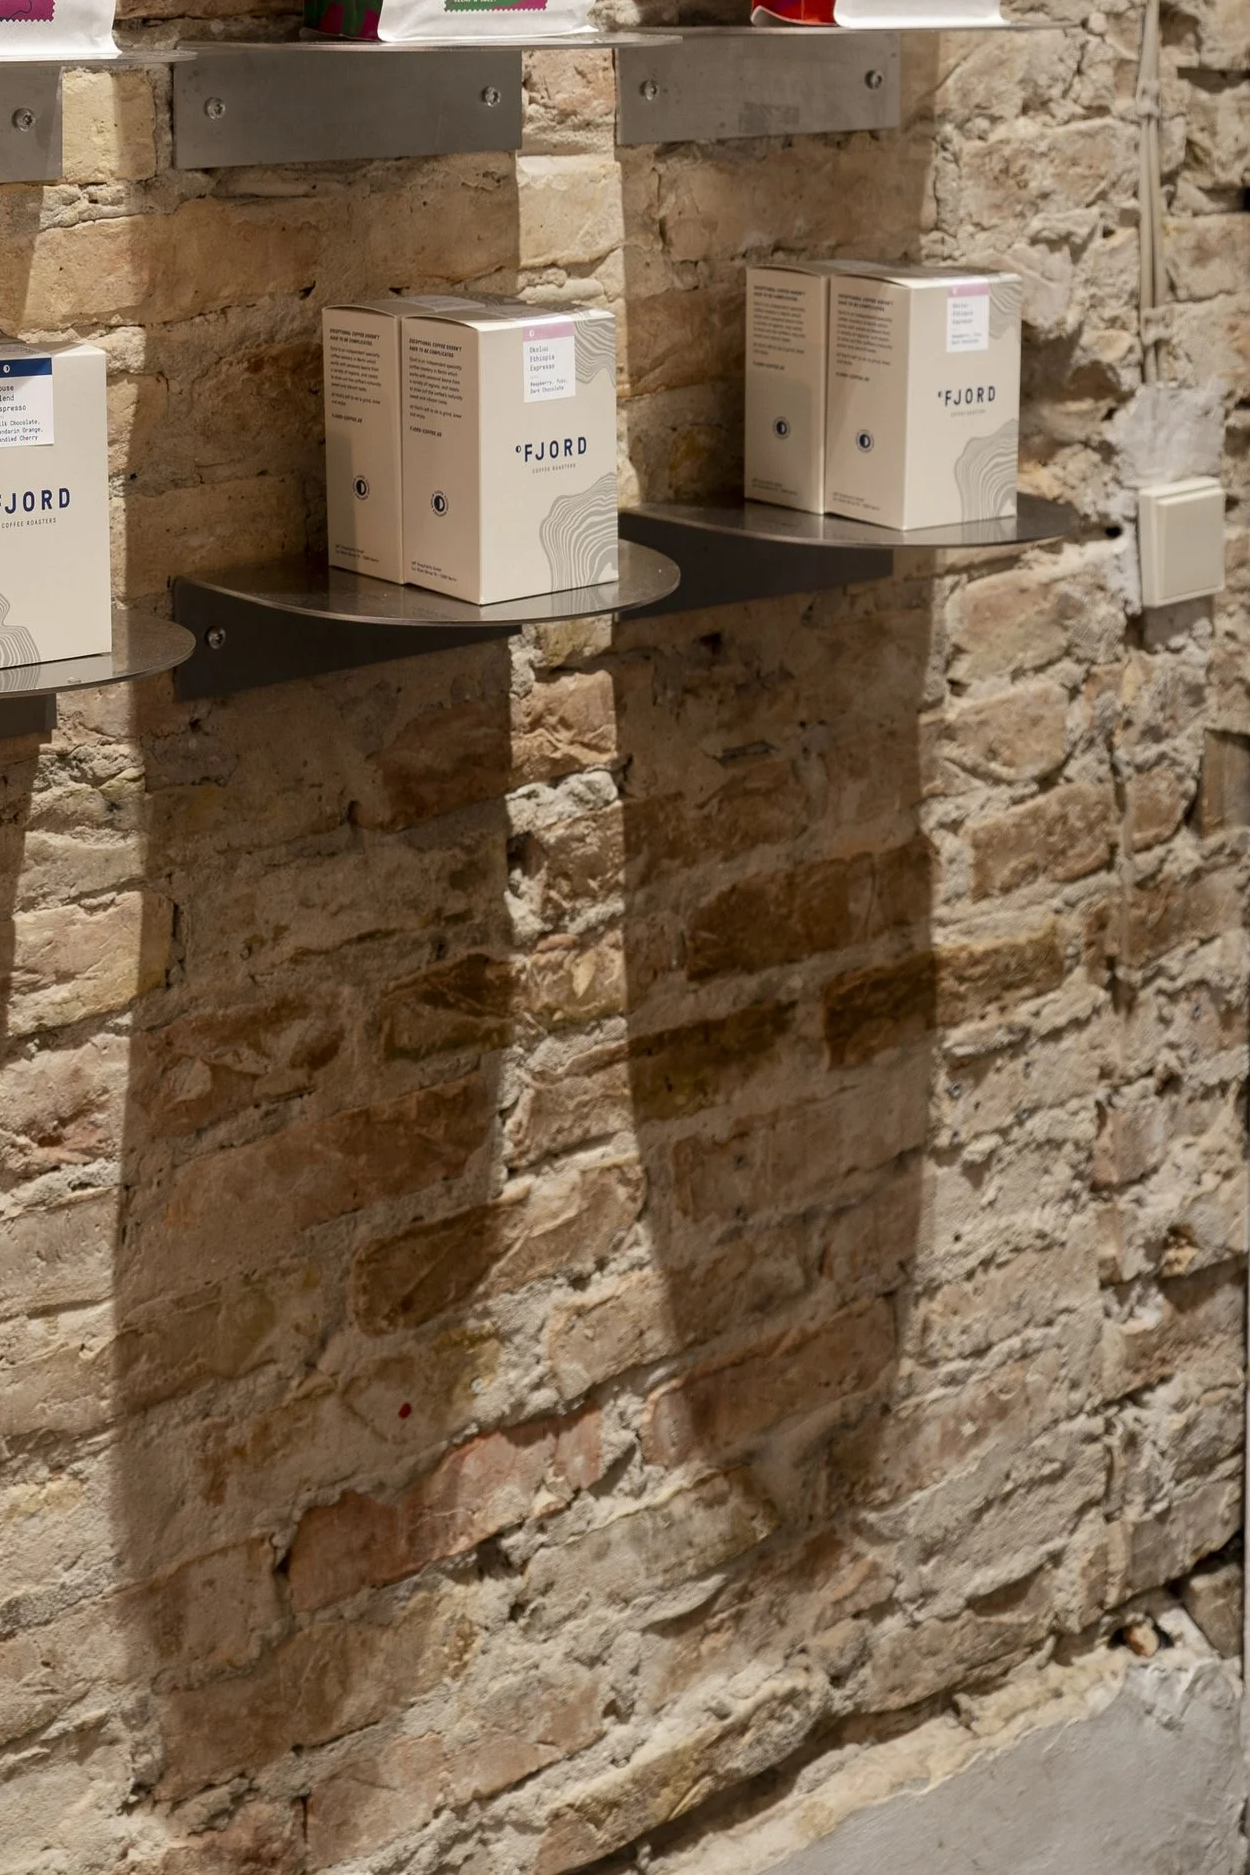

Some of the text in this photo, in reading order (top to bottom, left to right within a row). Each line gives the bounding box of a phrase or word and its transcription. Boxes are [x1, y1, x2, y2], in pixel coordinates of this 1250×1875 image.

[530, 354, 554, 362] Ethiopia
[530, 364, 555, 372] Espresso
[945, 386, 995, 407] FJORD
[525, 437, 586, 462] FJORD
[1, 518, 56, 529] COFFEE ROASTERS
